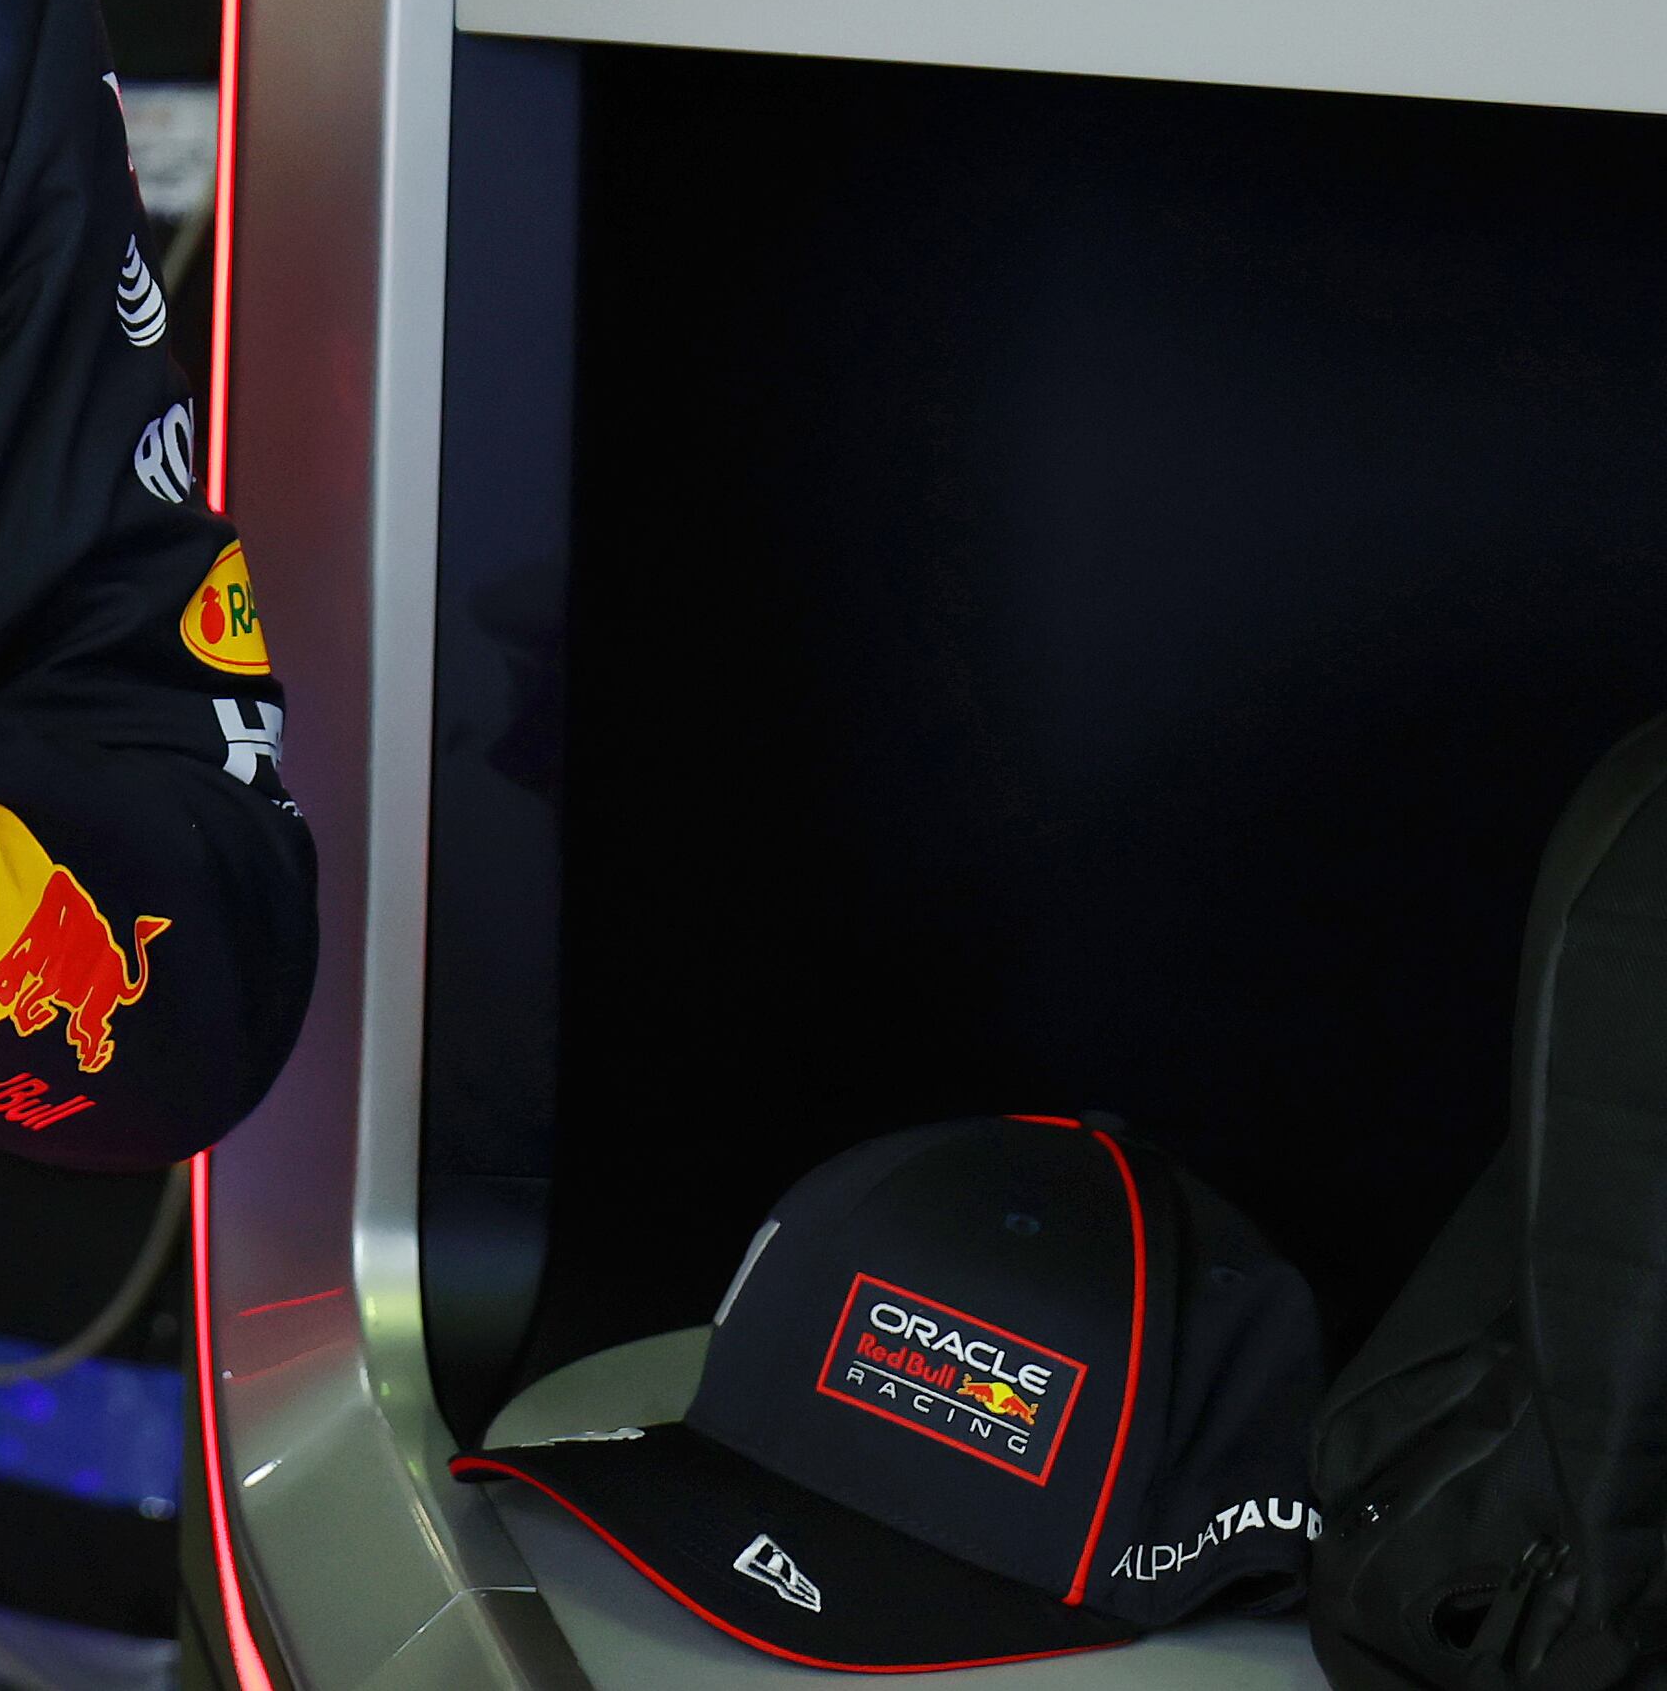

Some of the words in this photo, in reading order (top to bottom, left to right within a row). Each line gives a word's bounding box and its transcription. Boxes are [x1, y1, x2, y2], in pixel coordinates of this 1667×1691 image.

[855, 1331, 907, 1368] Red
[905, 1356, 958, 1390] Bull
[869, 1302, 1053, 1396] ORACLE
[845, 1366, 1030, 1455] RACING
